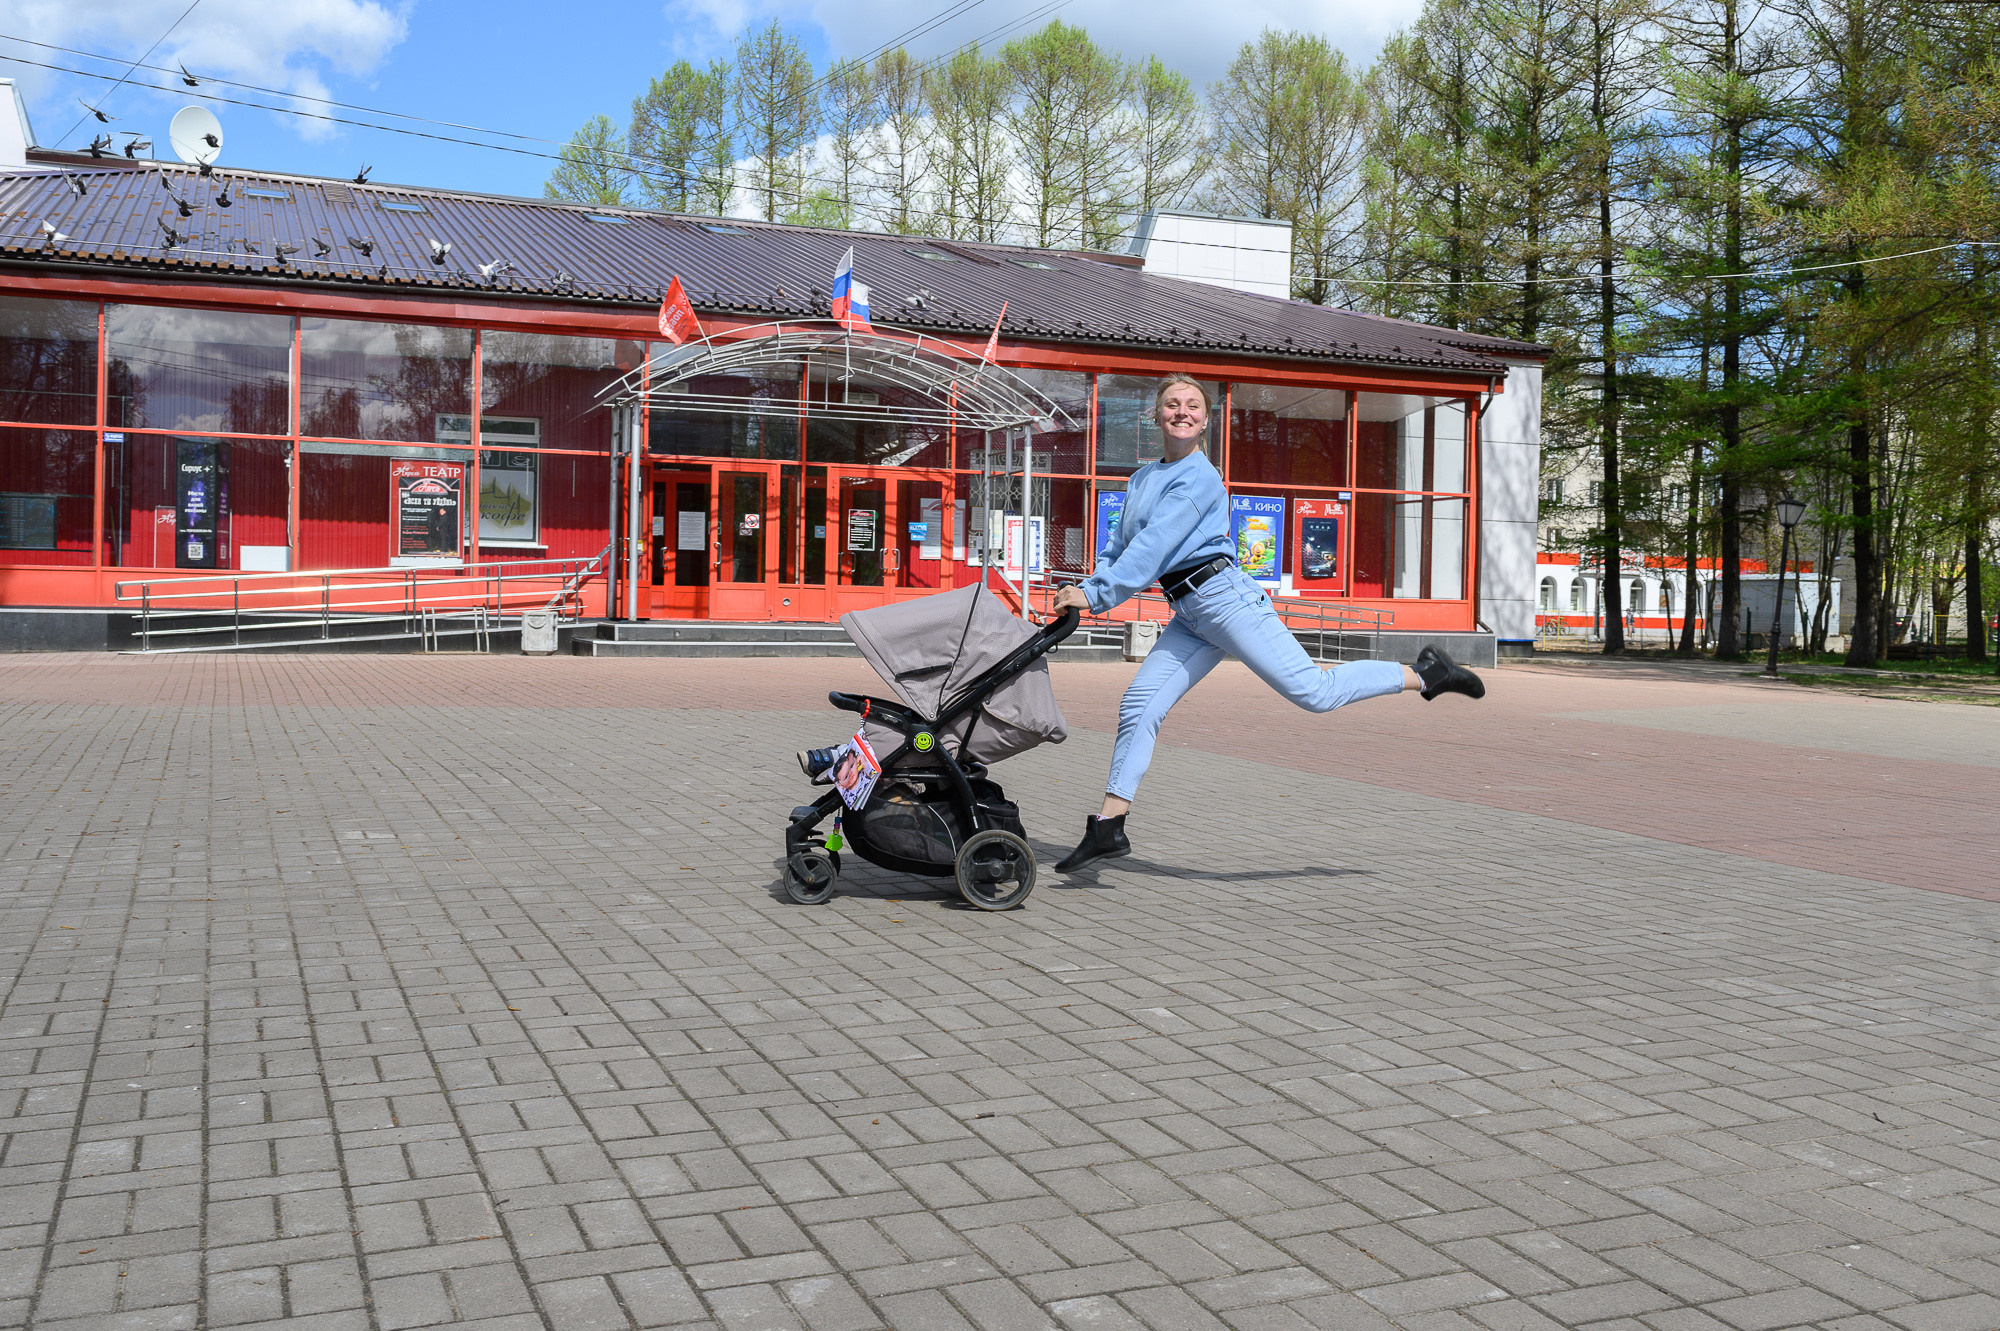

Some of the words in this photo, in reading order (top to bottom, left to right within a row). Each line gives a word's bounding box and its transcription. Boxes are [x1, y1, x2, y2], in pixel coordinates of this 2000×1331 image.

[423, 466, 462, 478] ТЕАТР
[1254, 502, 1282, 513] КИНО
[480, 501, 526, 527] кофе
